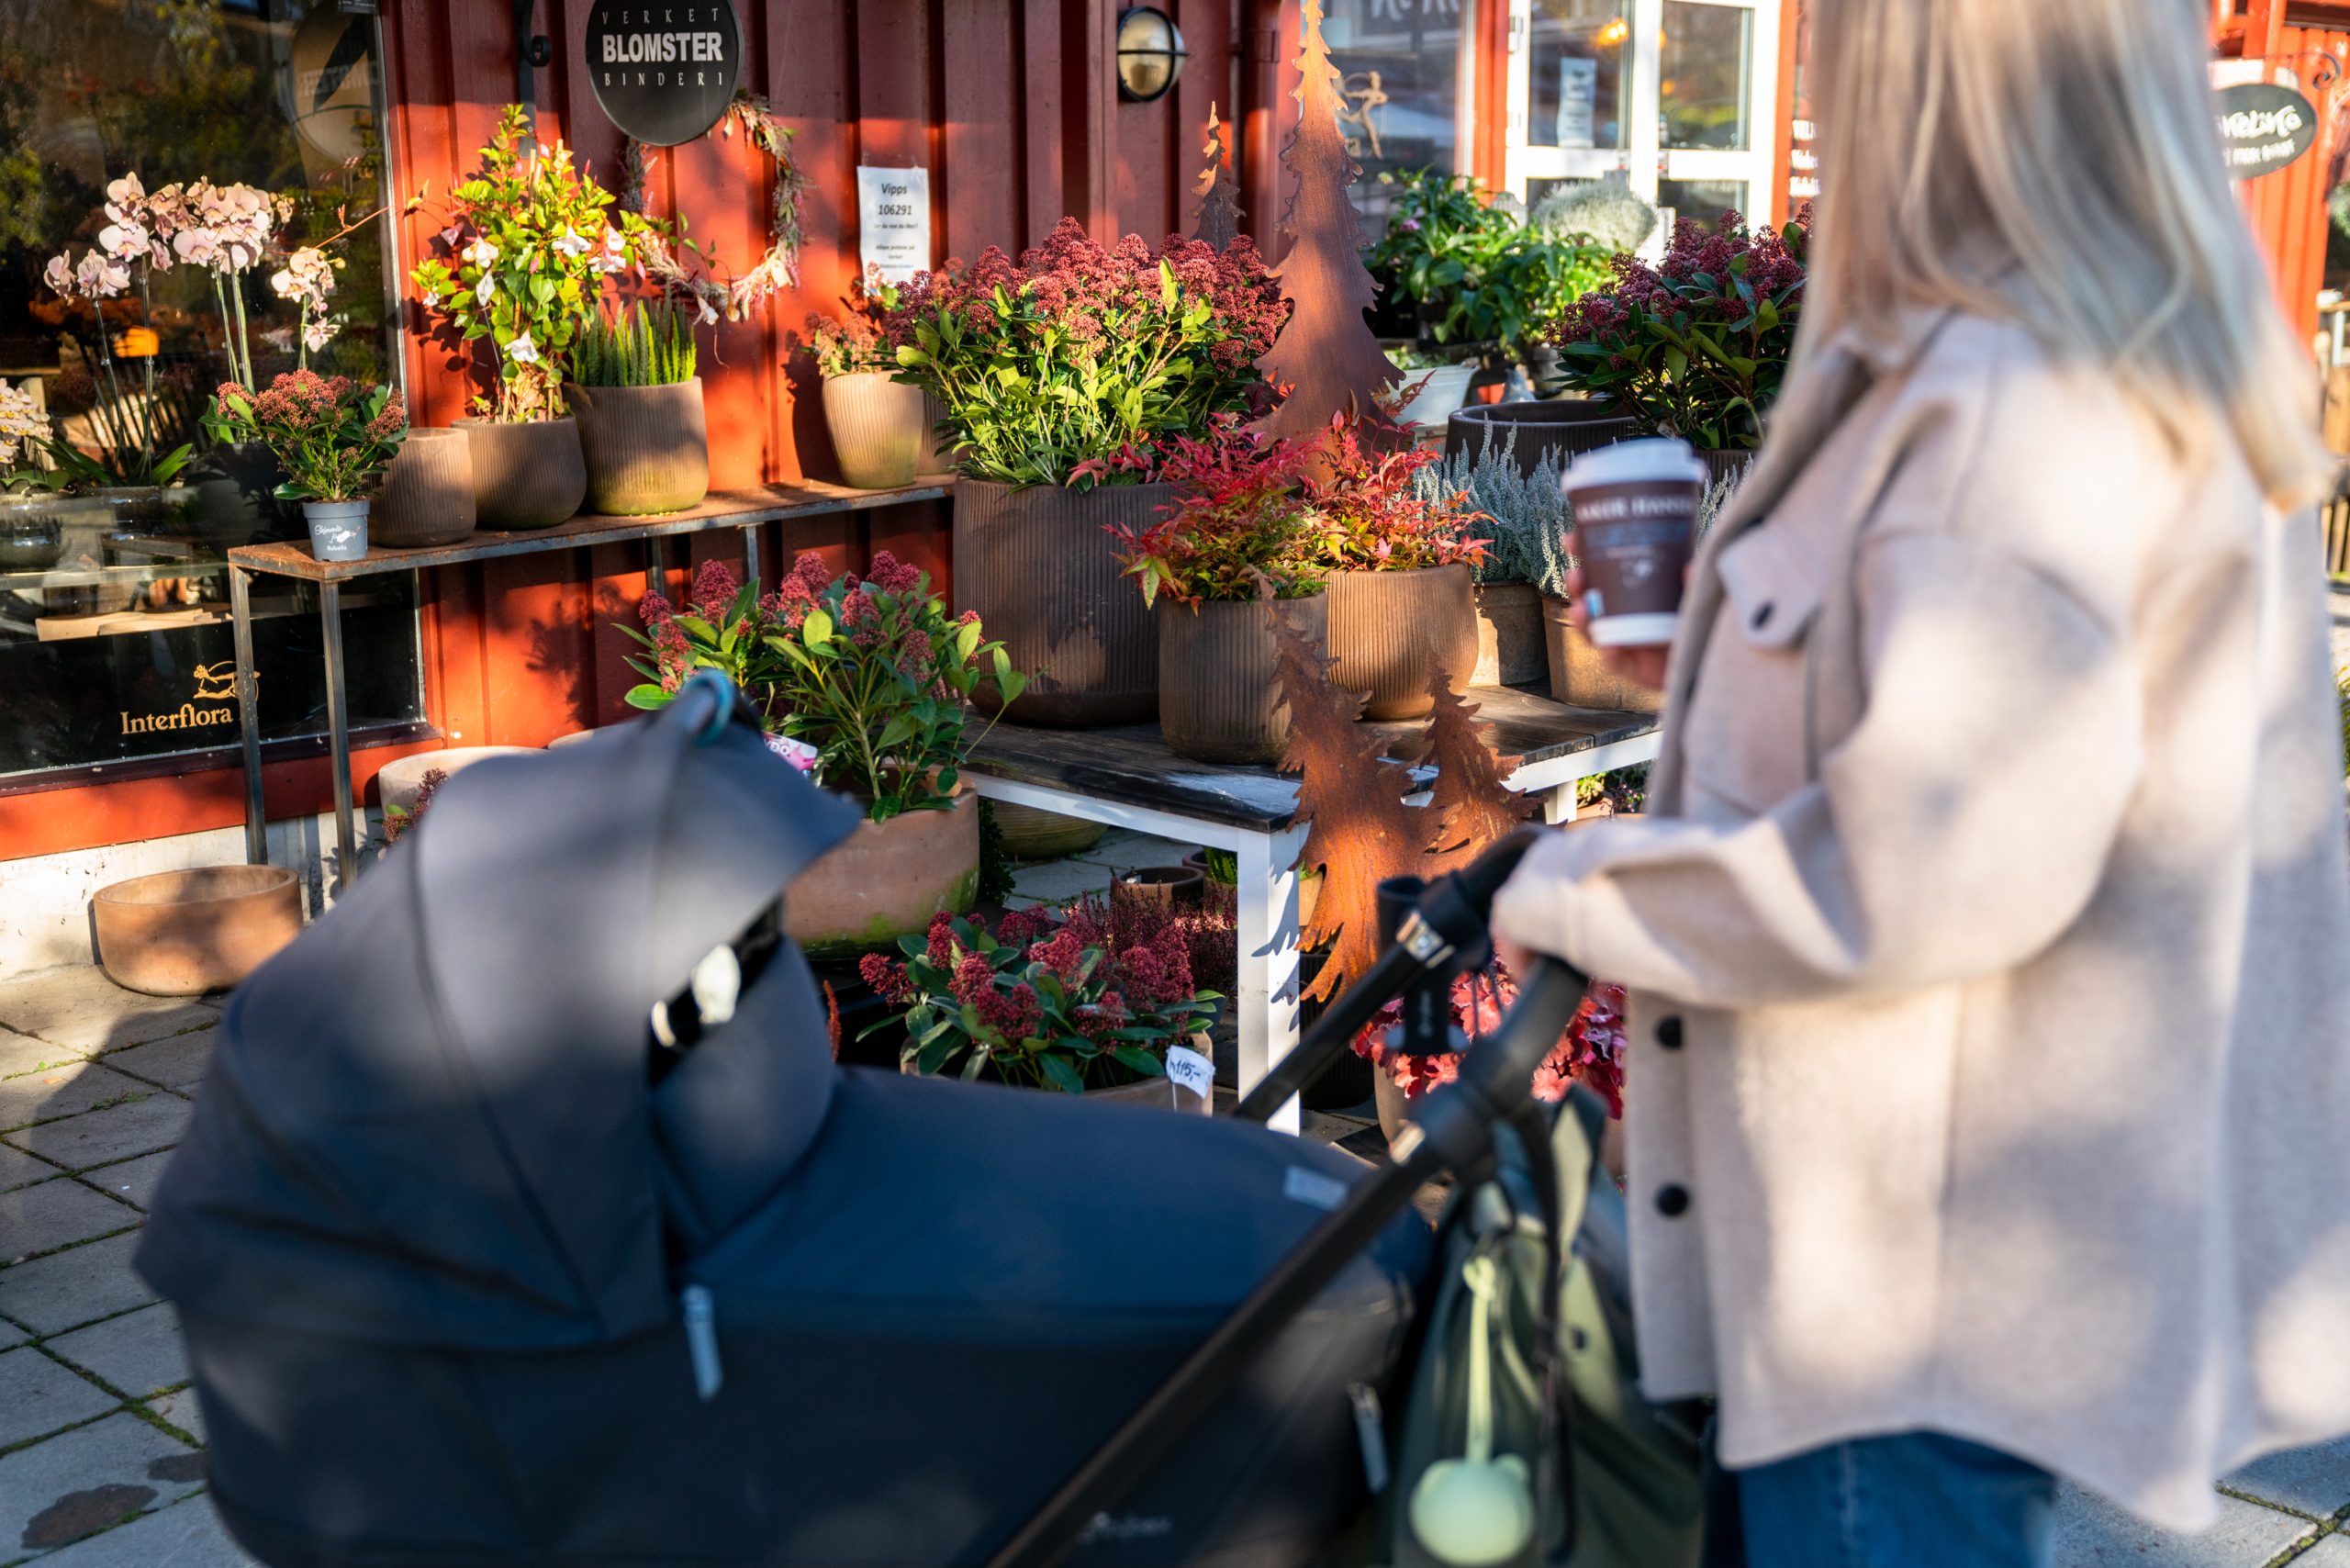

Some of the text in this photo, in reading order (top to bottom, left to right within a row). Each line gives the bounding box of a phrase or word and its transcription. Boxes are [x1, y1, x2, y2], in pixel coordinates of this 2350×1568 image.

[601, 8, 719, 26] VERKET
[602, 31, 723, 62] BLOMSTER
[604, 72, 722, 86] BINDERI
[881, 183, 907, 196] Vipps
[878, 204, 912, 215] 106291
[119, 703, 233, 734] Interflora
